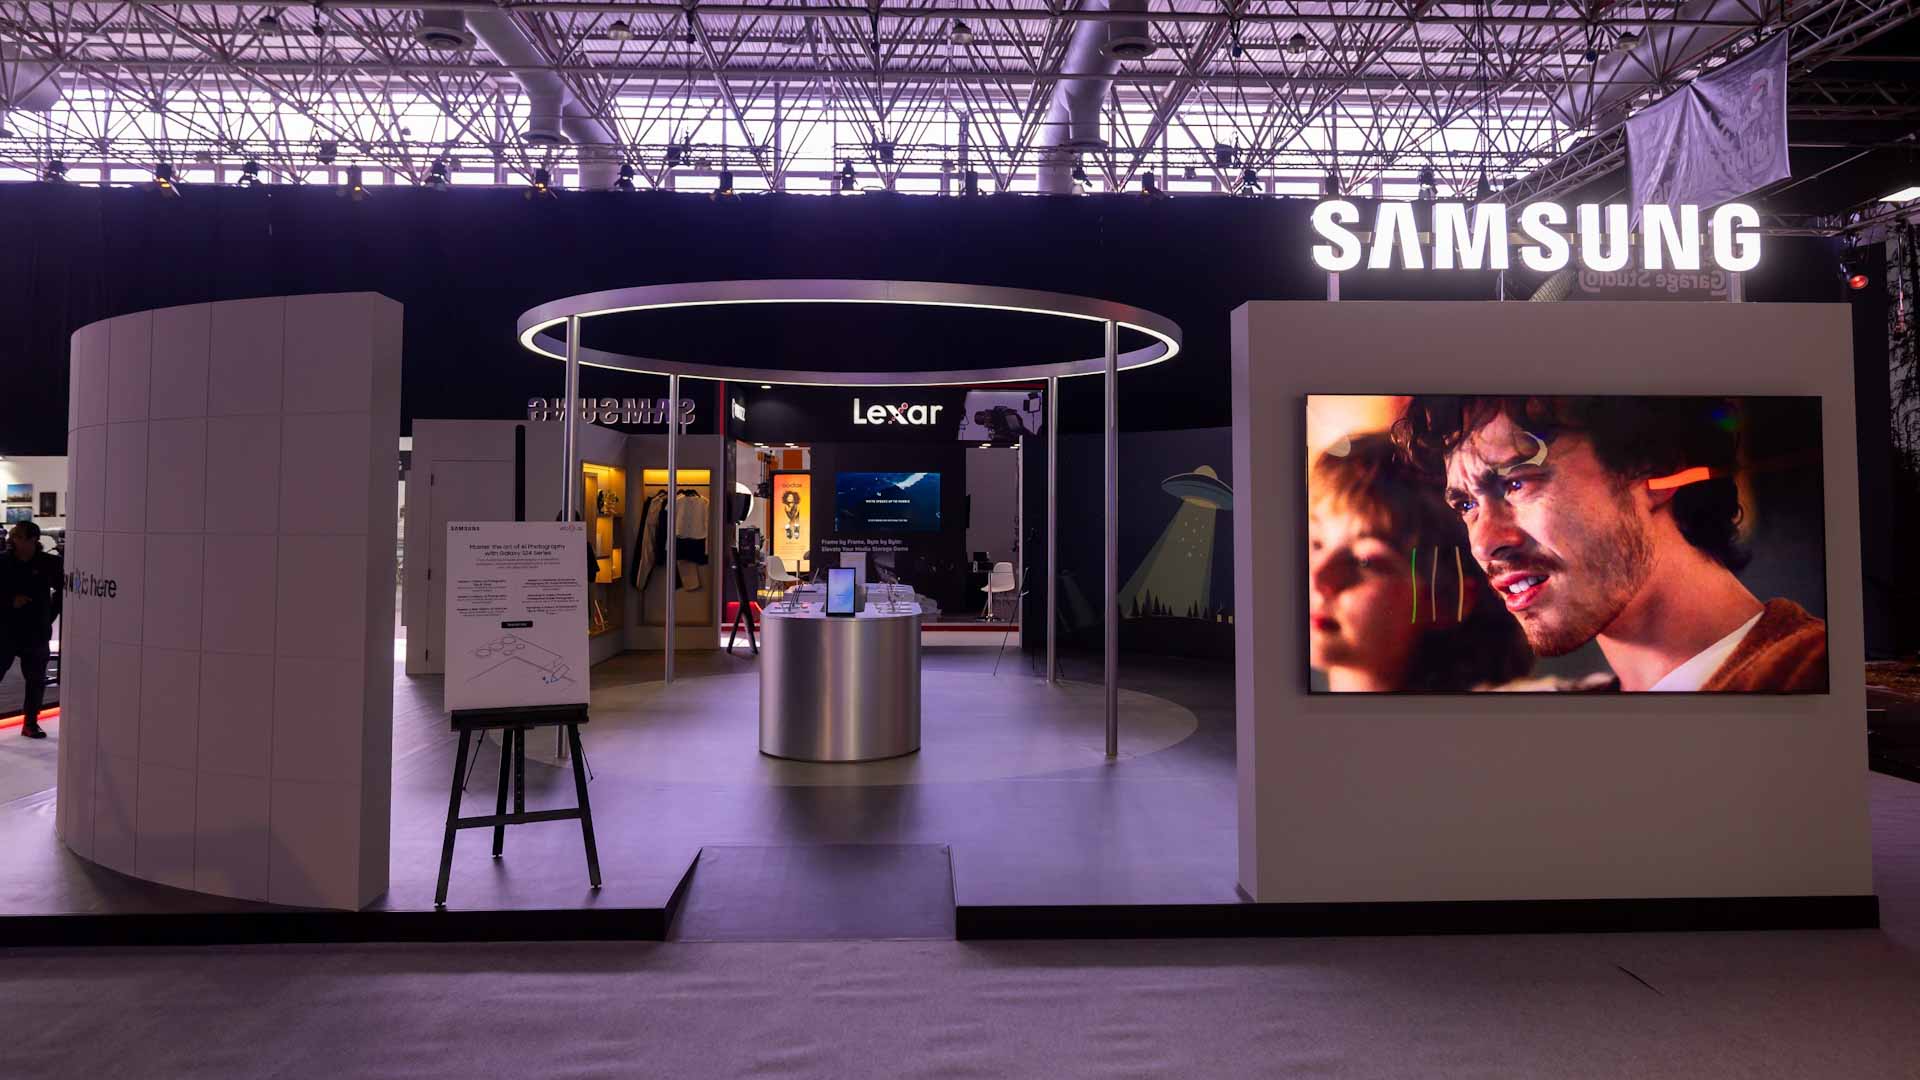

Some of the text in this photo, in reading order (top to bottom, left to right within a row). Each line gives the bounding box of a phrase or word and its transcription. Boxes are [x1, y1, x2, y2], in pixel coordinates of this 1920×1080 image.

[1311, 200, 1761, 272] SAMSUNG
[853, 398, 943, 425] Lexar
[90, 574, 117, 598] here
